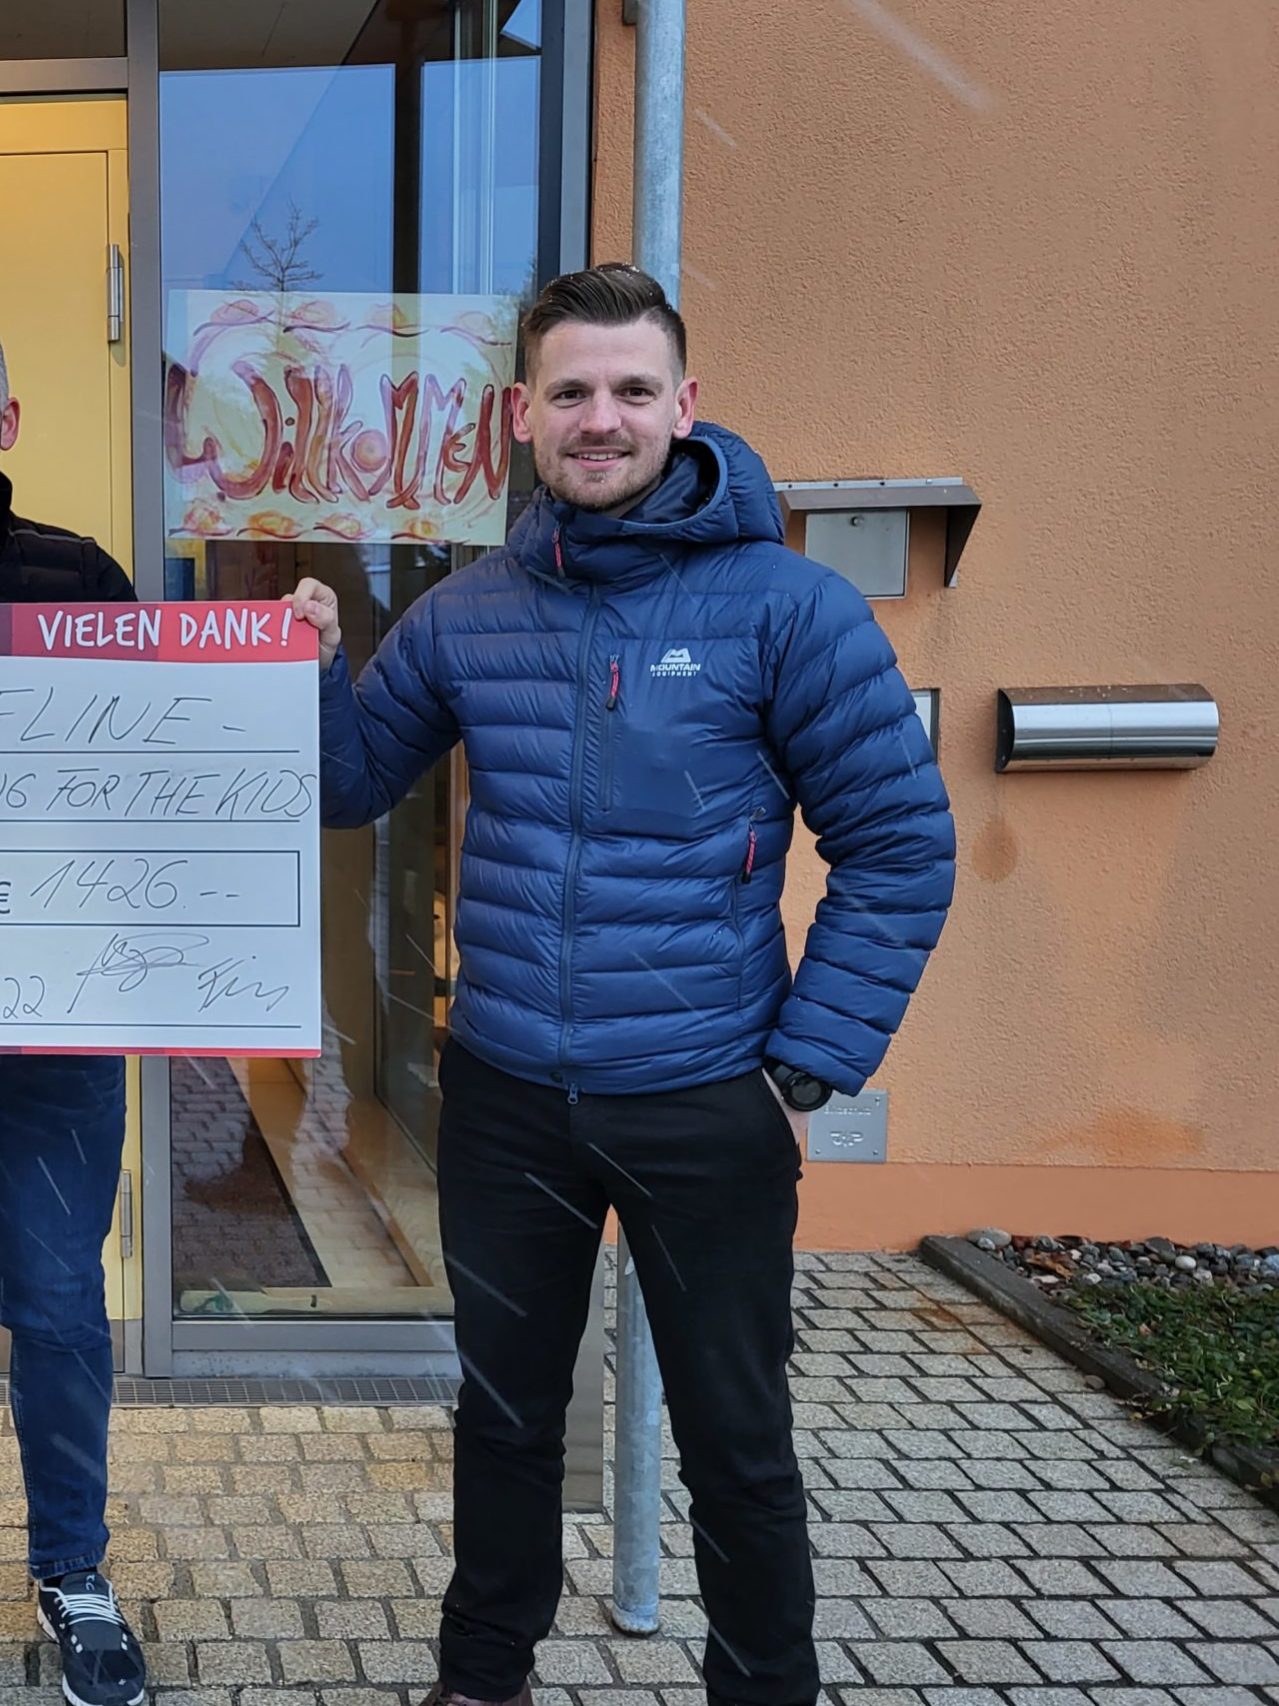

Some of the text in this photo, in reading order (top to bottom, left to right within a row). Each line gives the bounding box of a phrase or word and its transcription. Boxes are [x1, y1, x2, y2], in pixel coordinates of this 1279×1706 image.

[37, 608, 162, 651] VIELEN
[650, 663, 701, 672] MOUNTAIN
[45, 768, 121, 812] FOR
[124, 770, 221, 816] THE
[215, 768, 317, 822] KIDS
